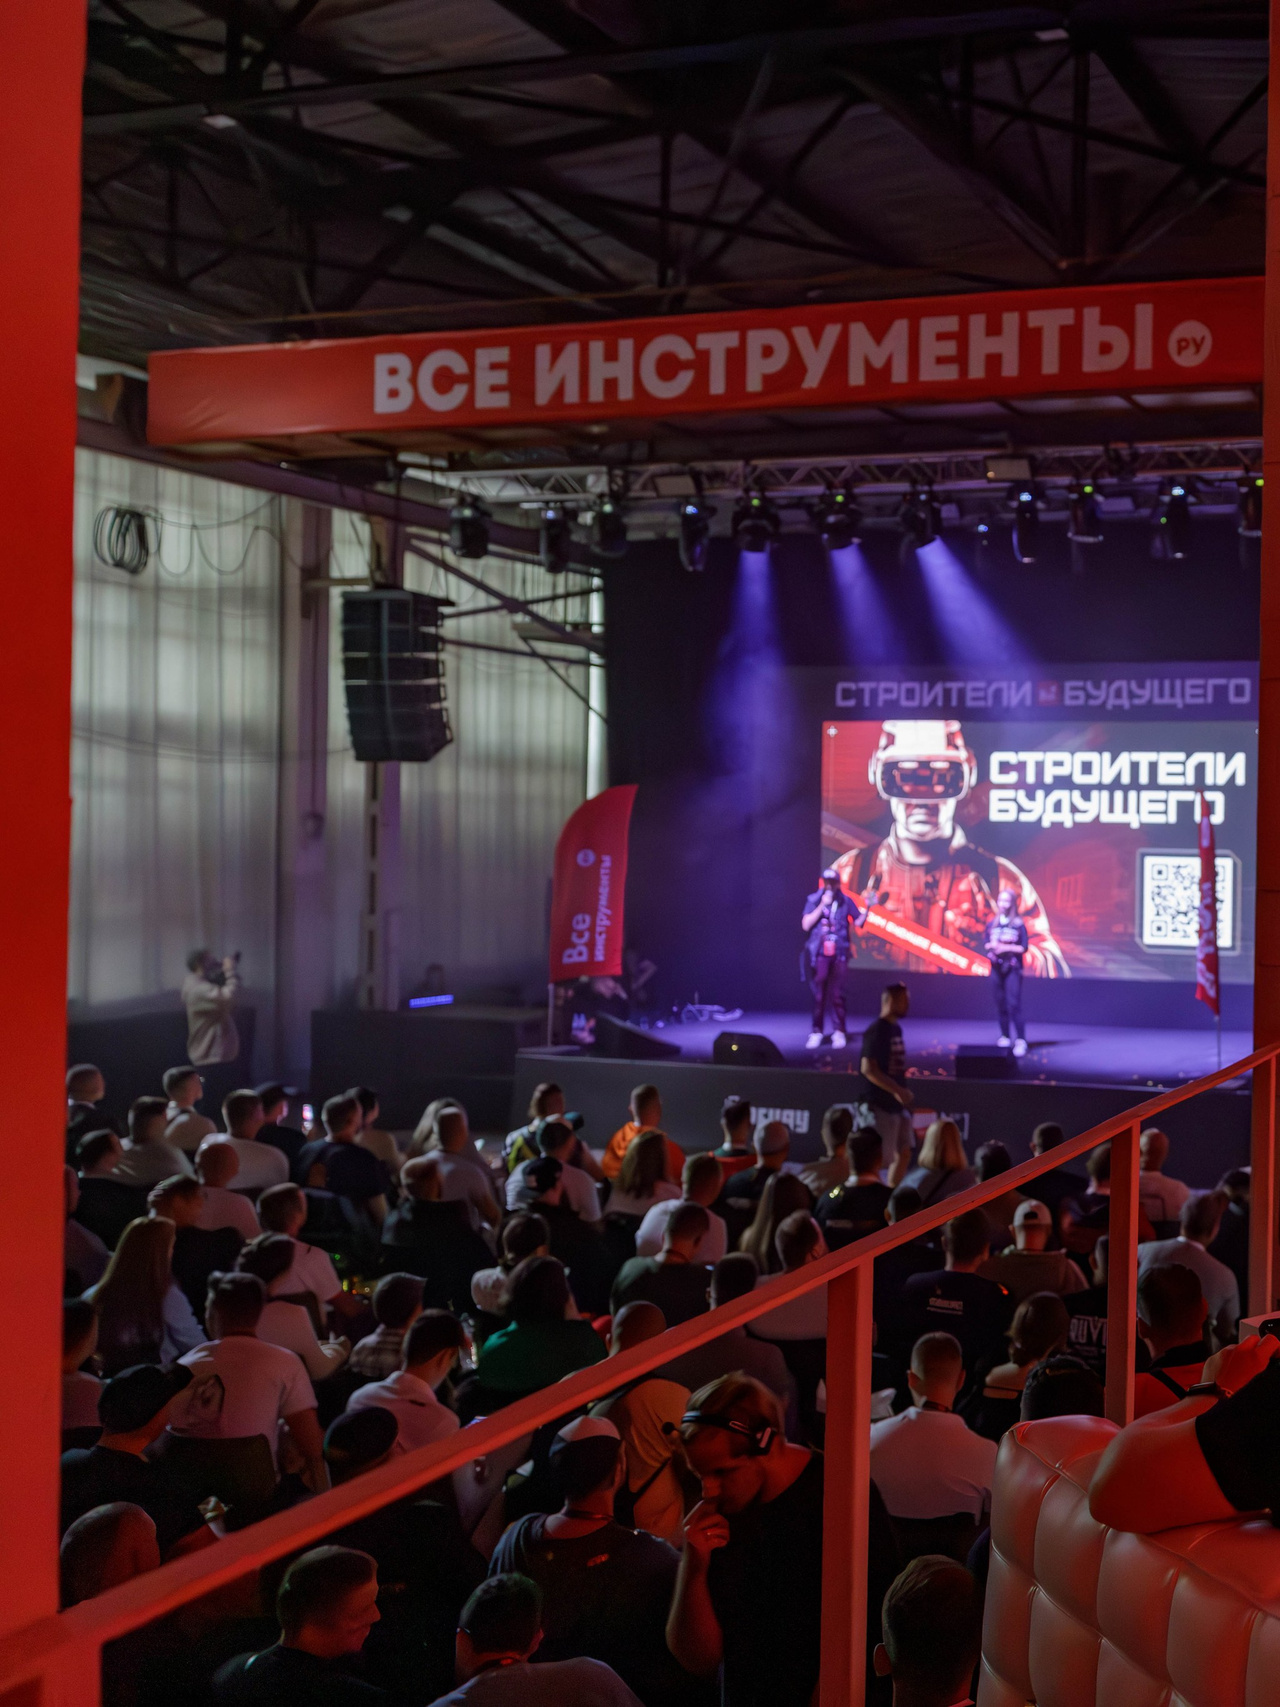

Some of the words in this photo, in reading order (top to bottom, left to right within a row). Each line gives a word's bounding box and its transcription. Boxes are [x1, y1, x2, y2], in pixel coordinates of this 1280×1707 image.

[373, 347, 510, 415] ВСЕ
[534, 303, 1154, 406] ИНСТРУМЕНТЫ
[835, 681, 1033, 708] СТРОИТЕЛИ
[1063, 678, 1252, 710] БУДУЩЕГО
[989, 752, 1247, 787] СТРОИТЕЛИ
[988, 789, 1226, 829] БУДУЩЕГО
[562, 912, 591, 965] Все
